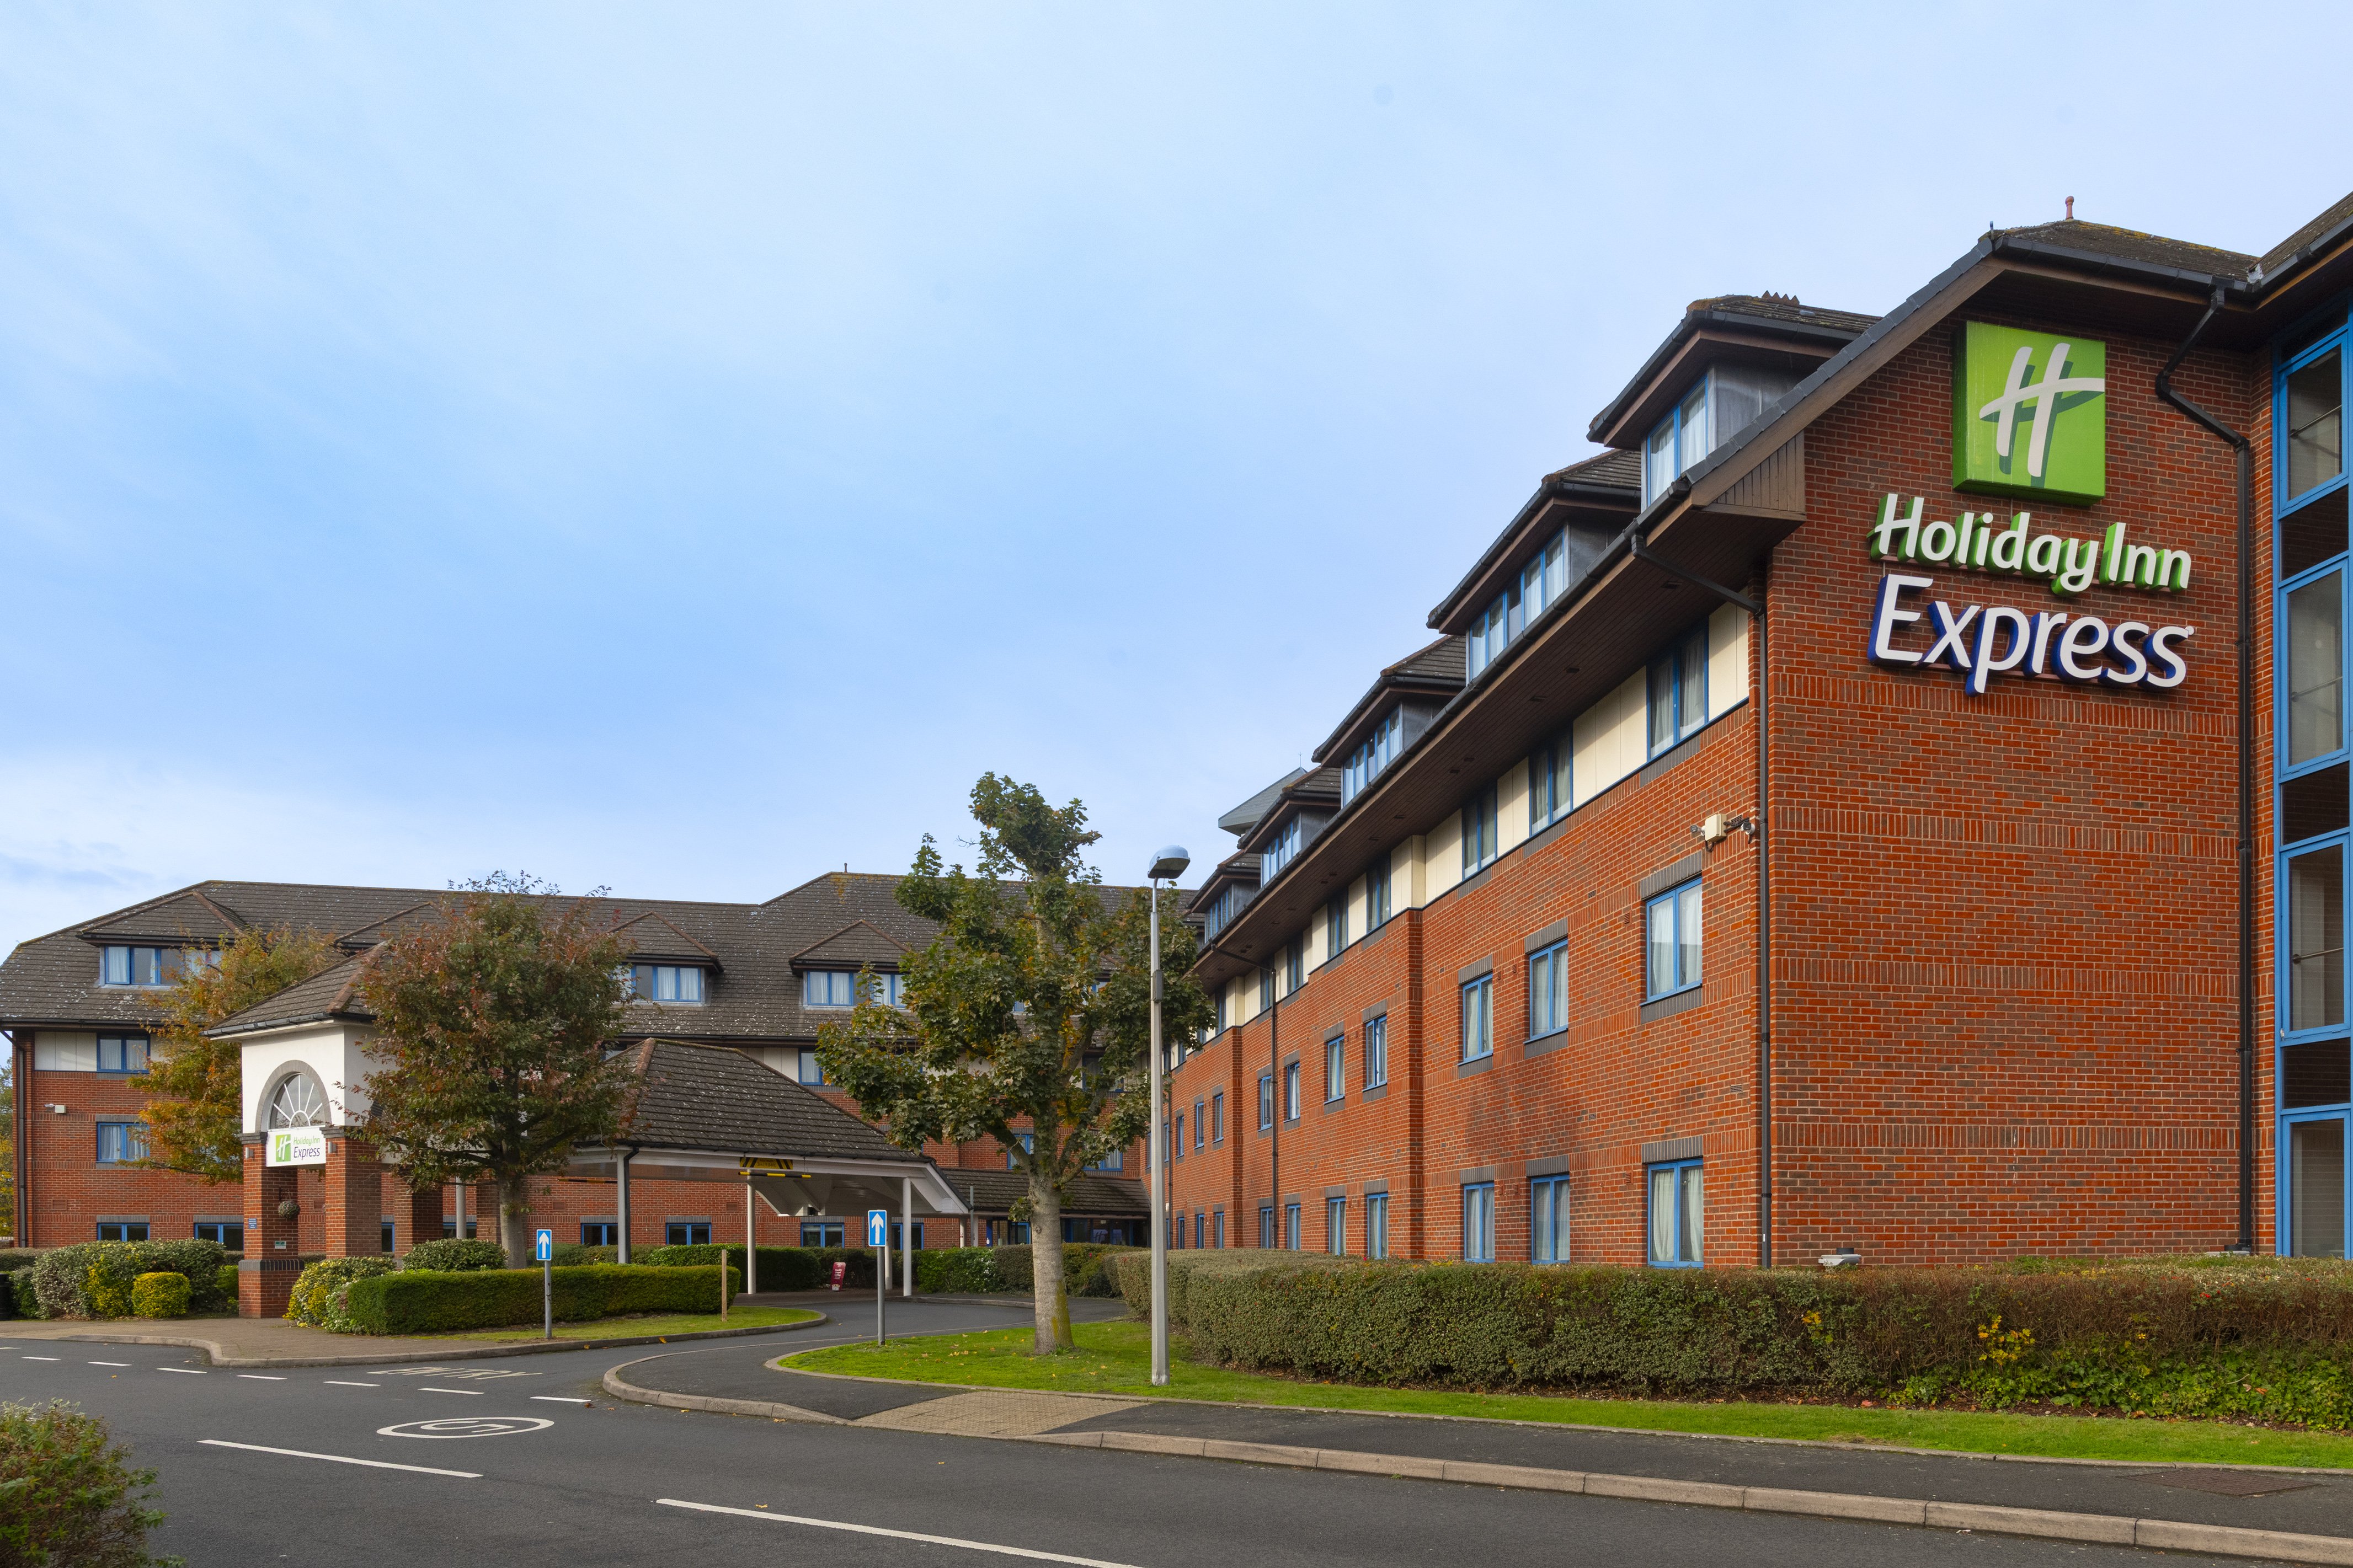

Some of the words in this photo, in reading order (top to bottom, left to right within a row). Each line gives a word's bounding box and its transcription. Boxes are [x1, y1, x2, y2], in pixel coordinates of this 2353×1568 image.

[1869, 493, 2099, 594] Holiday
[2102, 522, 2192, 592] Inn
[1870, 574, 2189, 695] Express
[294, 1136, 312, 1146] Holiday
[294, 1146, 320, 1160] Express
[366, 1367, 543, 1380] ENTRY
